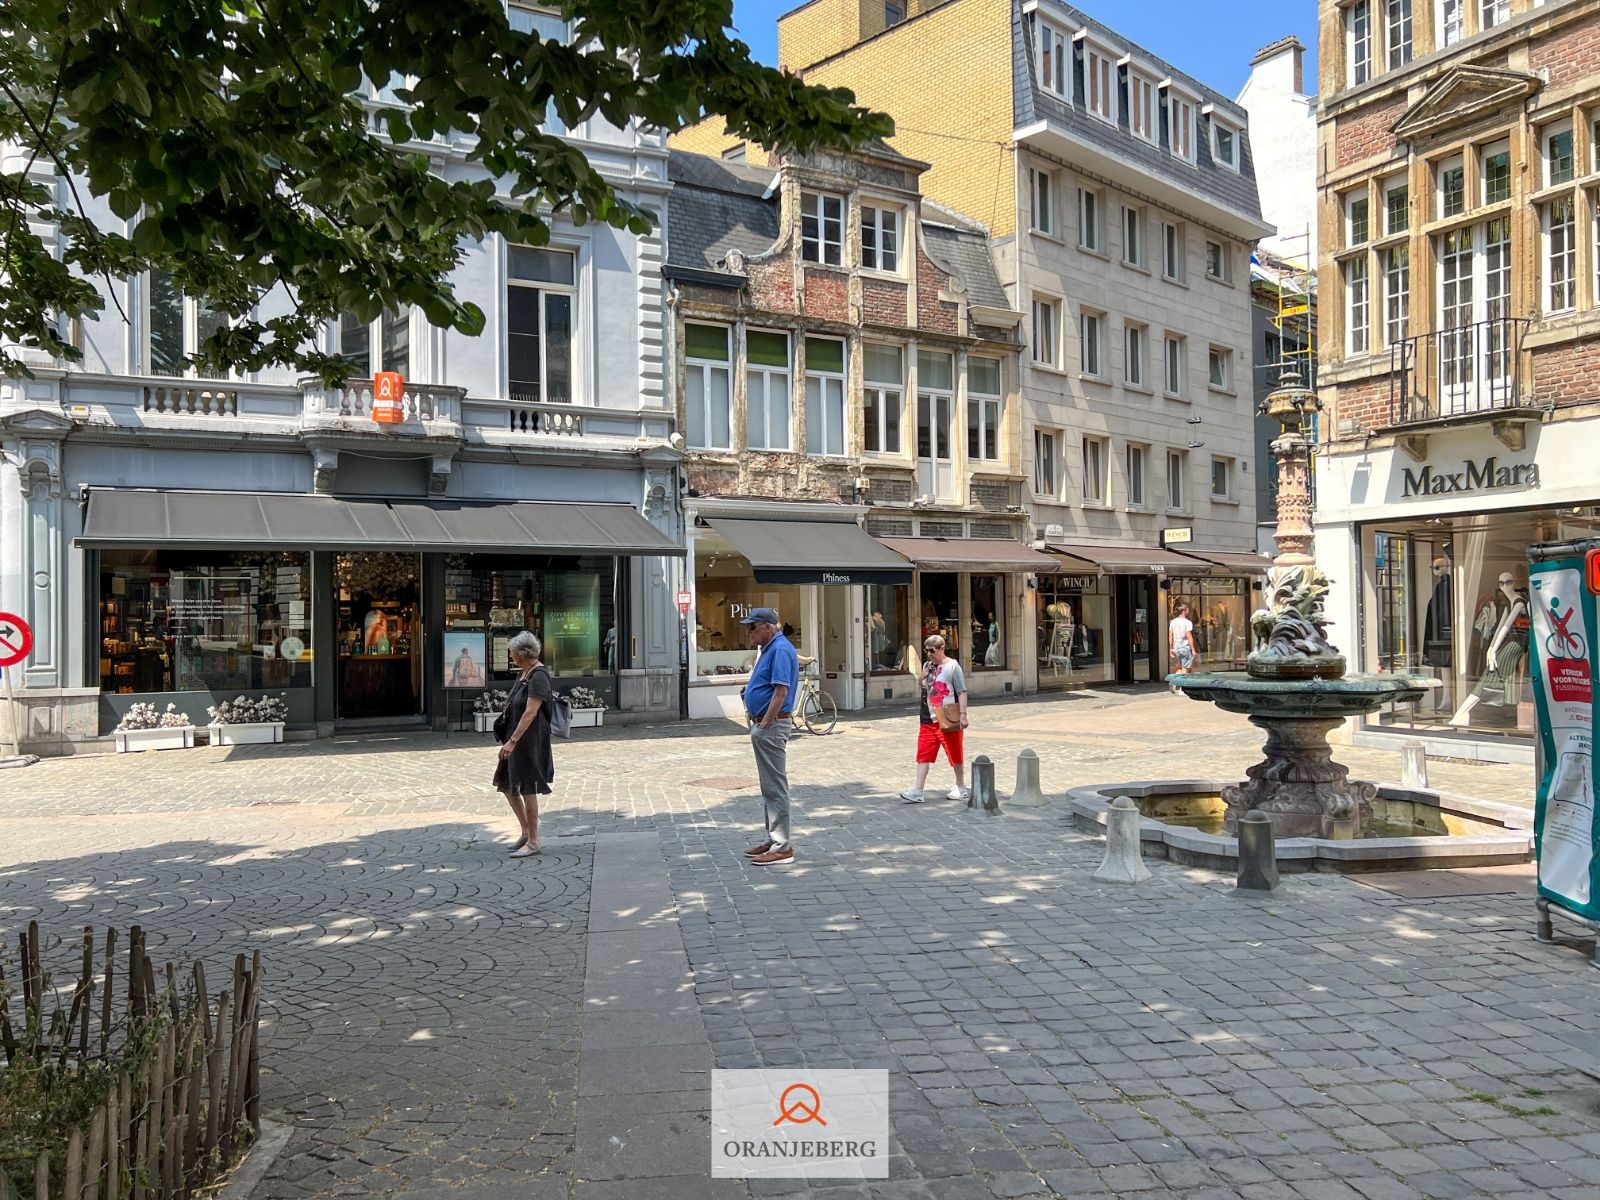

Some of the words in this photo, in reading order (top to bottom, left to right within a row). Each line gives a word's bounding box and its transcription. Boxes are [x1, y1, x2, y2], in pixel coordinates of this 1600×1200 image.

[1401, 457, 1541, 498] MaxMara
[823, 572, 850, 583] Phiness
[1063, 577, 1090, 588] WINCH
[1552, 676, 1572, 684] VOOR
